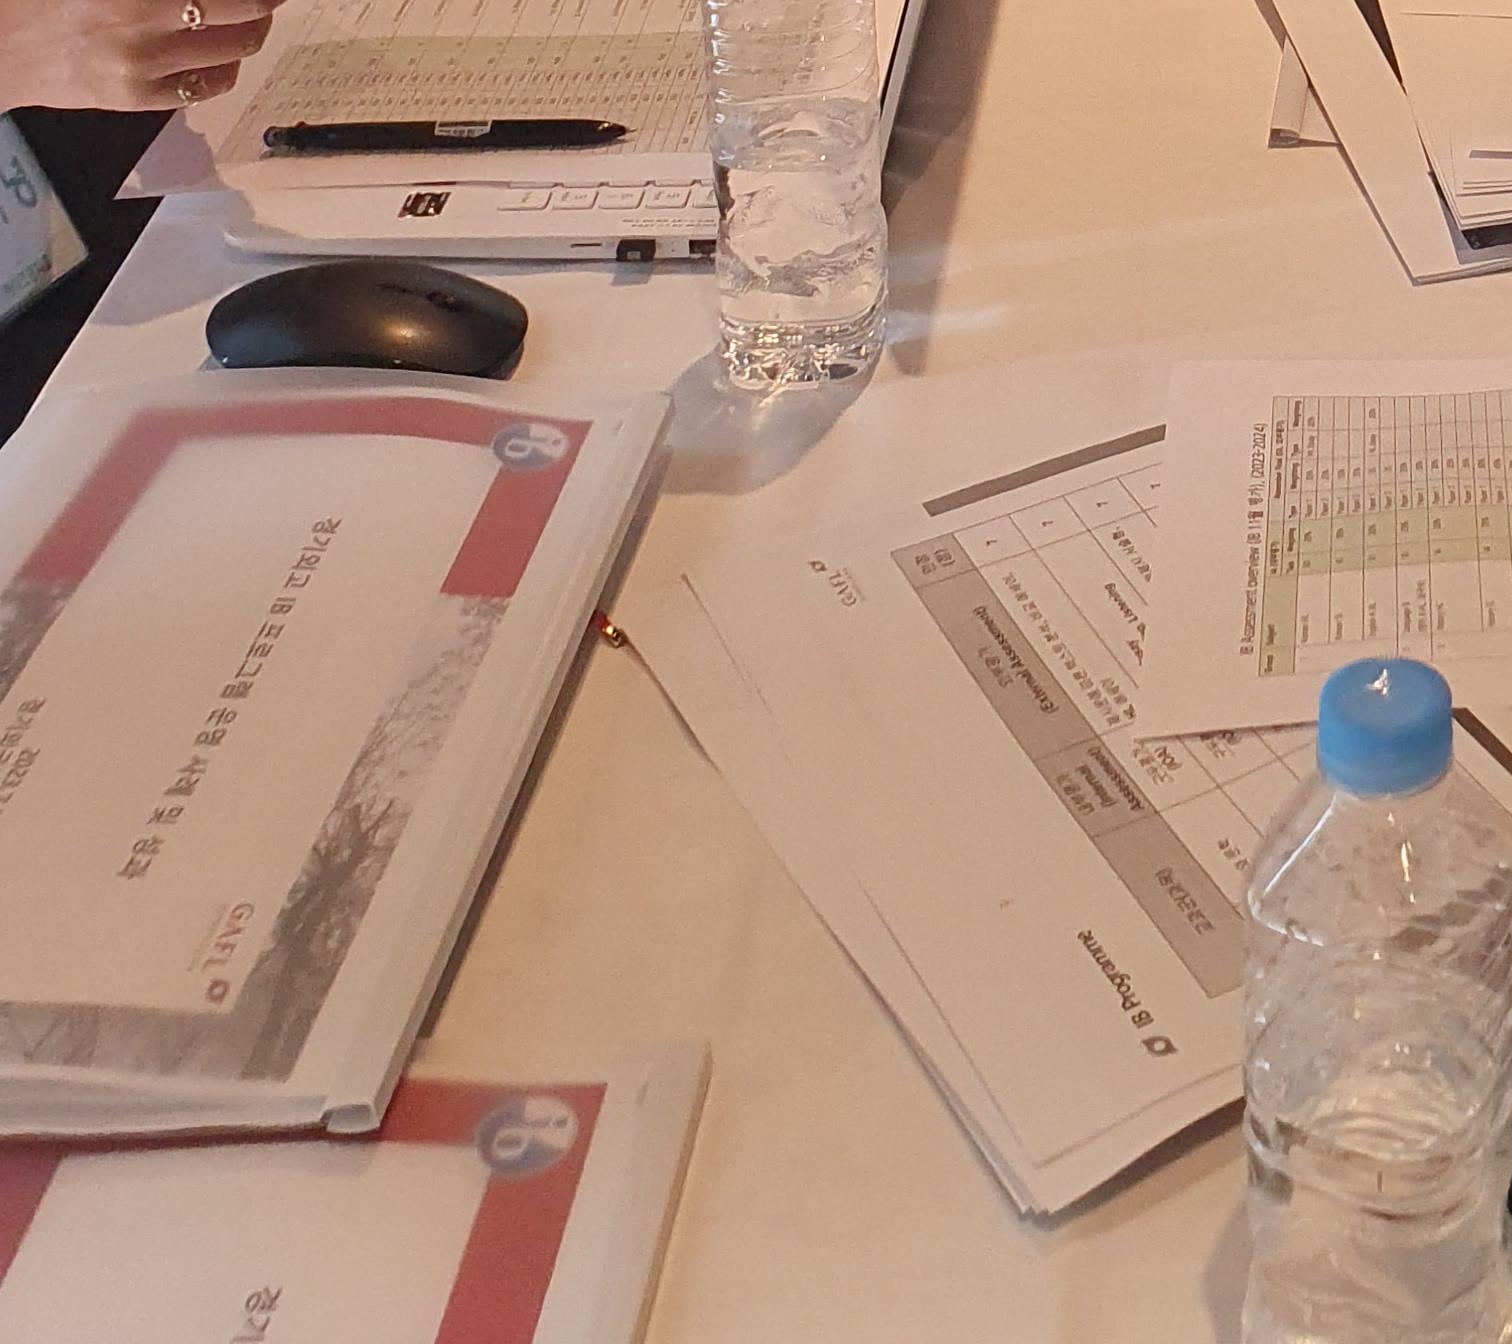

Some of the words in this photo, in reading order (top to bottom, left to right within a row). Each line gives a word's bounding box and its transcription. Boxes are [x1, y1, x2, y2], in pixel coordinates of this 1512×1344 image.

[284, 518, 342, 588] 경기외고
[269, 597, 296, 614] IB
[220, 621, 285, 699] 프로그램
[195, 707, 238, 746] 운영
[1077, 928, 1141, 1010] Programme
[1130, 1007, 1154, 1030] IB
